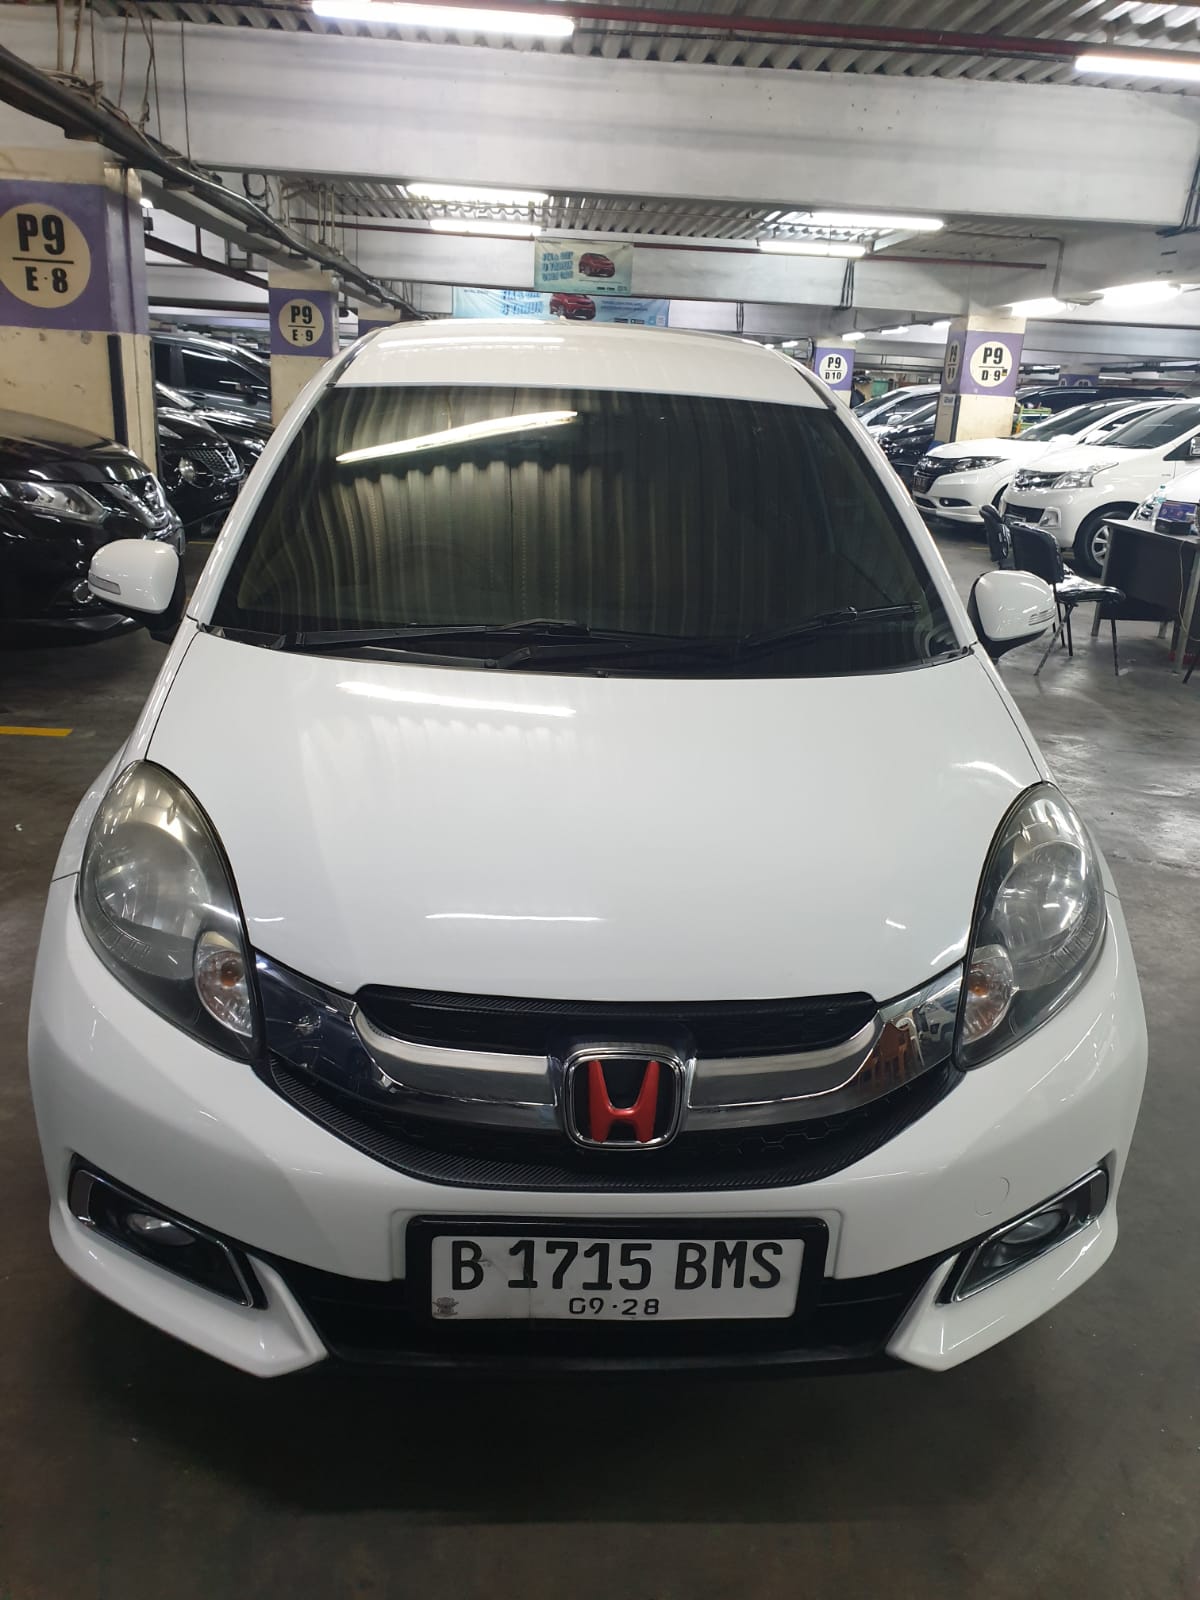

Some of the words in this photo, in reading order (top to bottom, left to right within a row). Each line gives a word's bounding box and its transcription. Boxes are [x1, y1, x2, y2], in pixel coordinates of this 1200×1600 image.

[16, 213, 65, 255] P9
[290, 305, 313, 324] P9
[827, 356, 842, 369] P9
[982, 346, 1004, 365] P9
[451, 1239, 485, 1291] B
[508, 1239, 653, 1291] 1715
[674, 1241, 784, 1291] BMS
